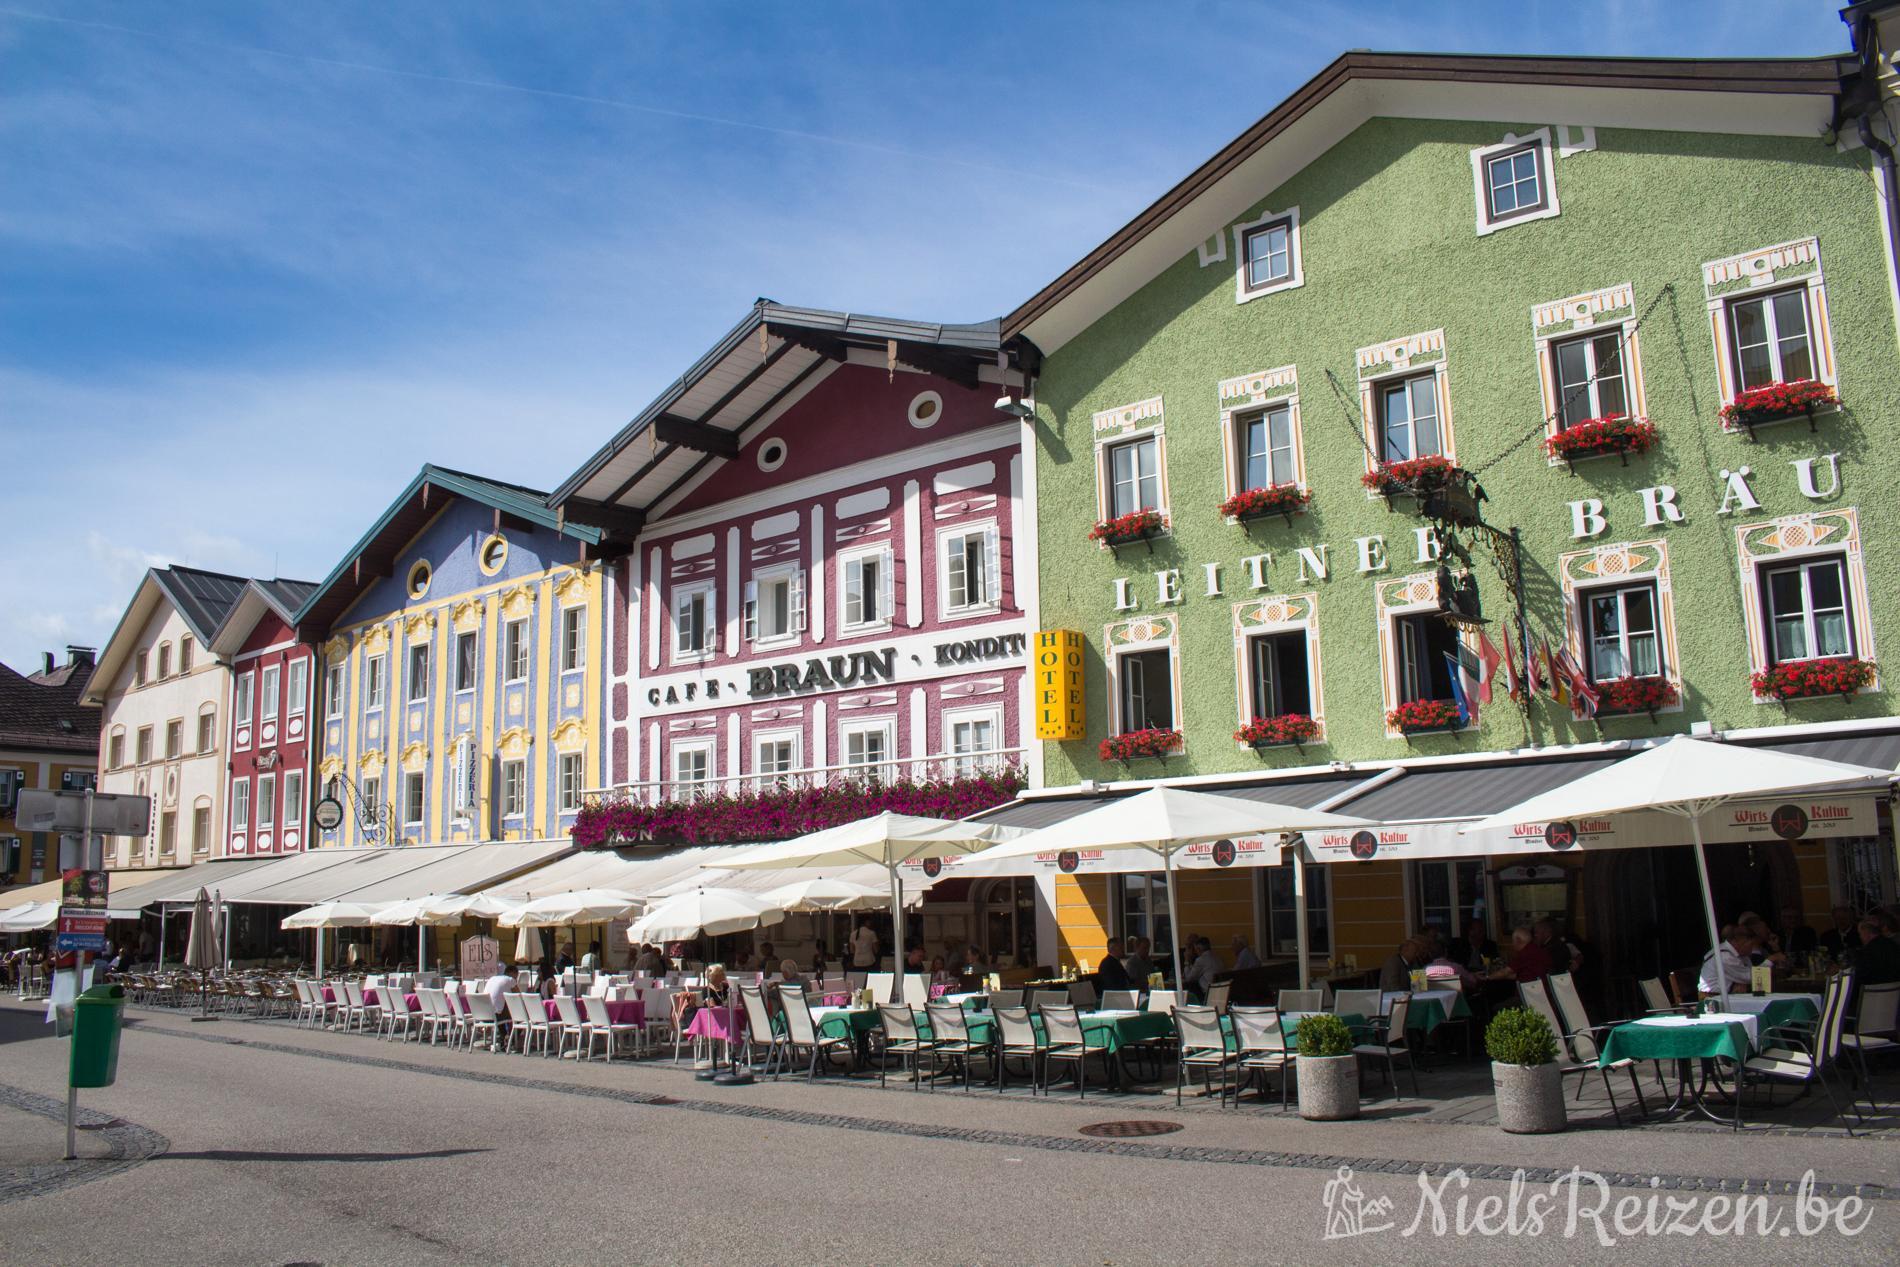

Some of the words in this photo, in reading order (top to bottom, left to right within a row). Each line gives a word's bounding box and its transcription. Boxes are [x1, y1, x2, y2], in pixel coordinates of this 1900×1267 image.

[1112, 526, 1452, 611] LEITNER
[1566, 453, 1840, 538] BRÄU
[648, 679, 720, 706] CAFE
[747, 647, 897, 697] BRAUN
[1041, 633, 1057, 723] HOTEL
[1068, 633, 1080, 723] HOTEL
[468, 744, 477, 807] PIZZERIA
[1380, 832, 1408, 844] Kultur
[1811, 804, 1849, 819] Kultur
